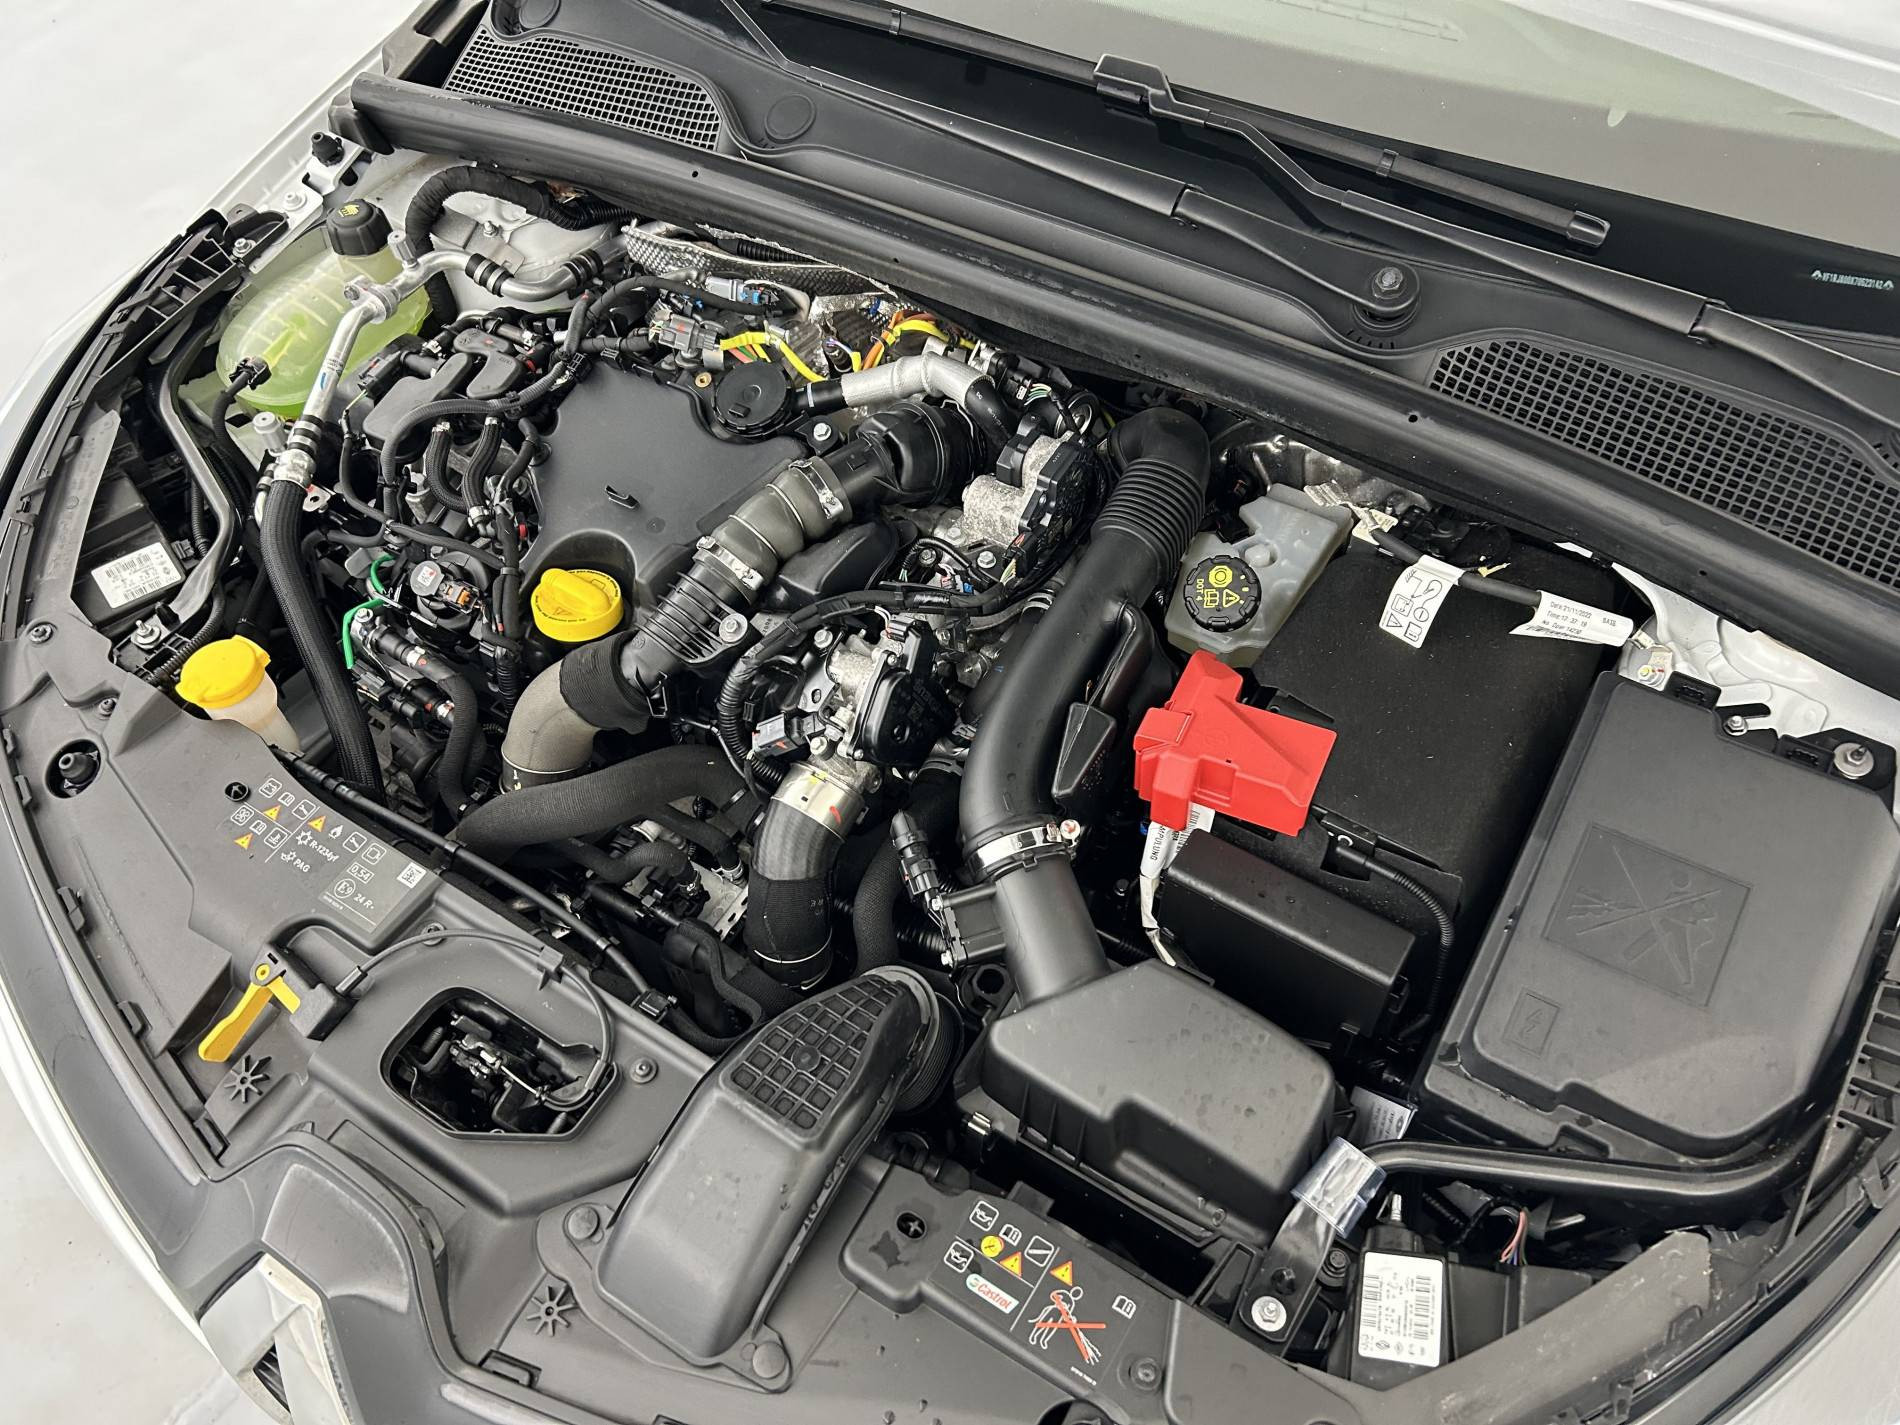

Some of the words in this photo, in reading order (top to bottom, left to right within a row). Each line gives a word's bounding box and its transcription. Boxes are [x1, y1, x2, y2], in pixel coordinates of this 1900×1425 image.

[1196, 578, 1204, 594] DOT
[1150, 825, 1166, 861] MPULUNG
[293, 858, 311, 872] PAG
[978, 1283, 1013, 1310] Castrol
